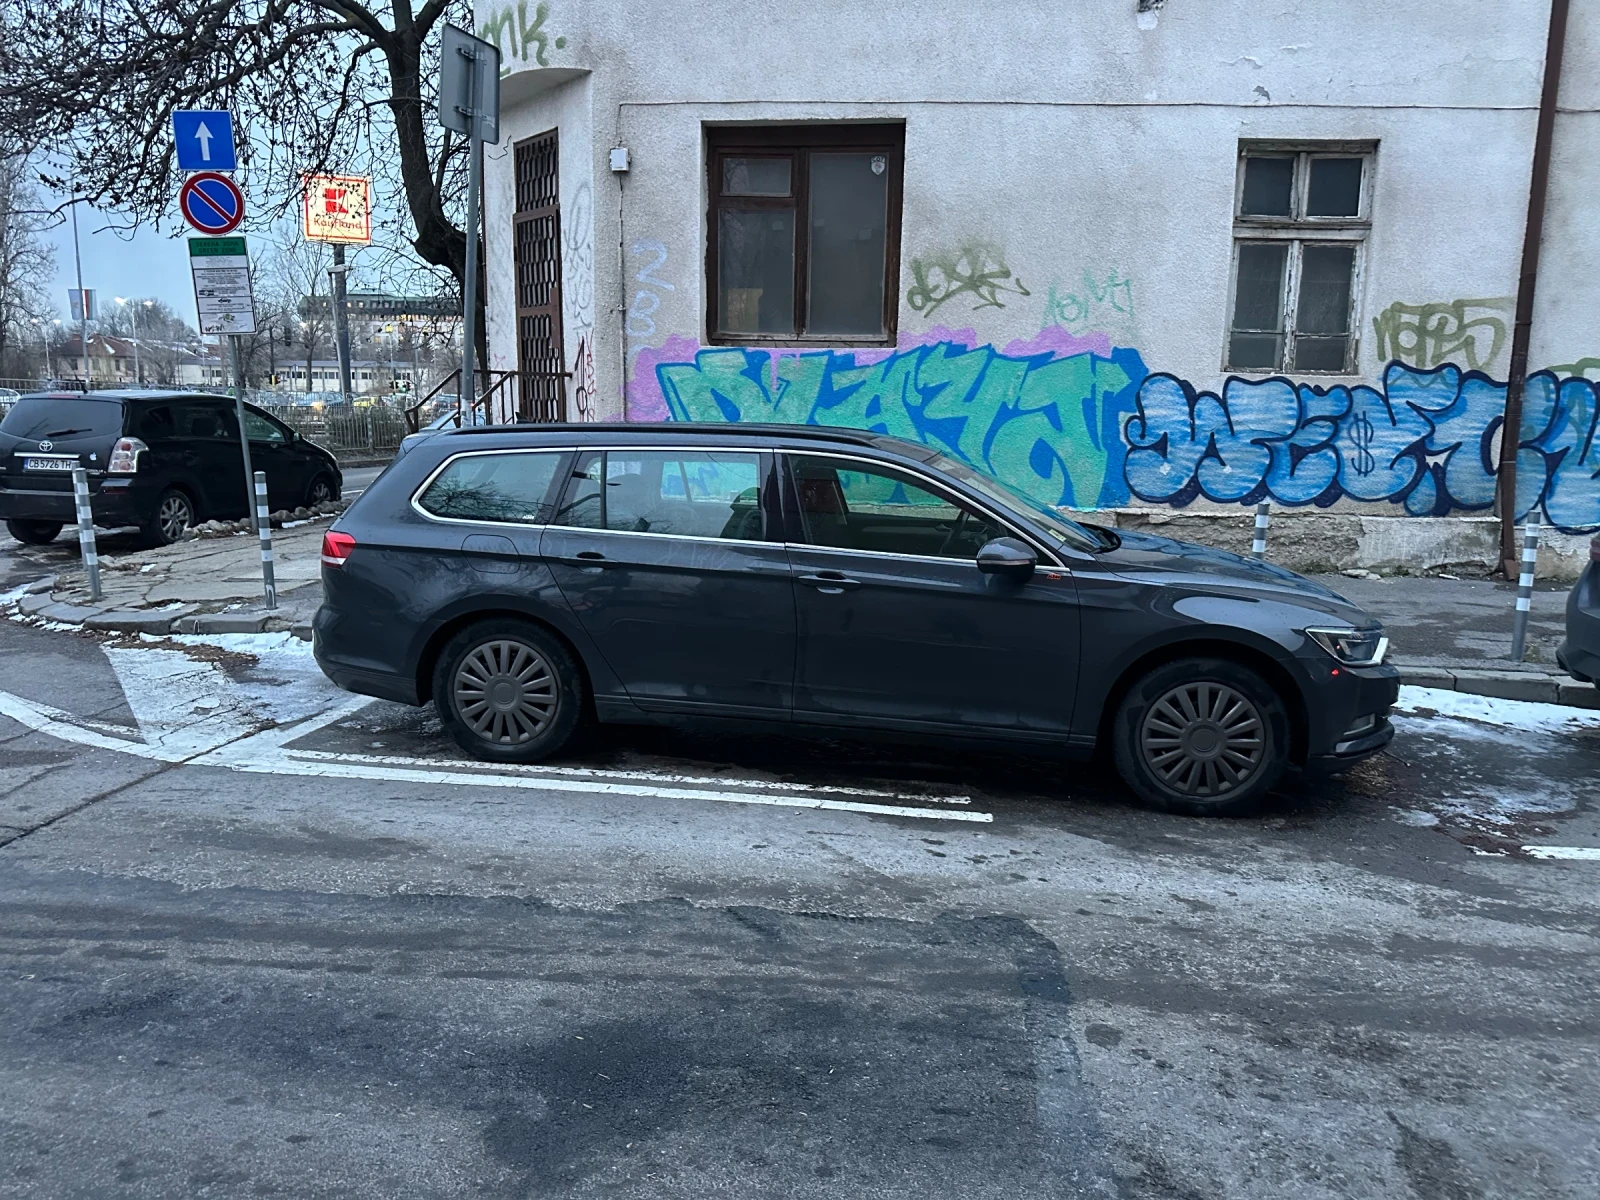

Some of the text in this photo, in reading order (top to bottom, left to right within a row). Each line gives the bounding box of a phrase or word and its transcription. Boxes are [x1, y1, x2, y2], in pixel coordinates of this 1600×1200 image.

[314, 217, 363, 231] Kaufland
[28, 459, 39, 469] CB
[40, 460, 60, 470] 5726
